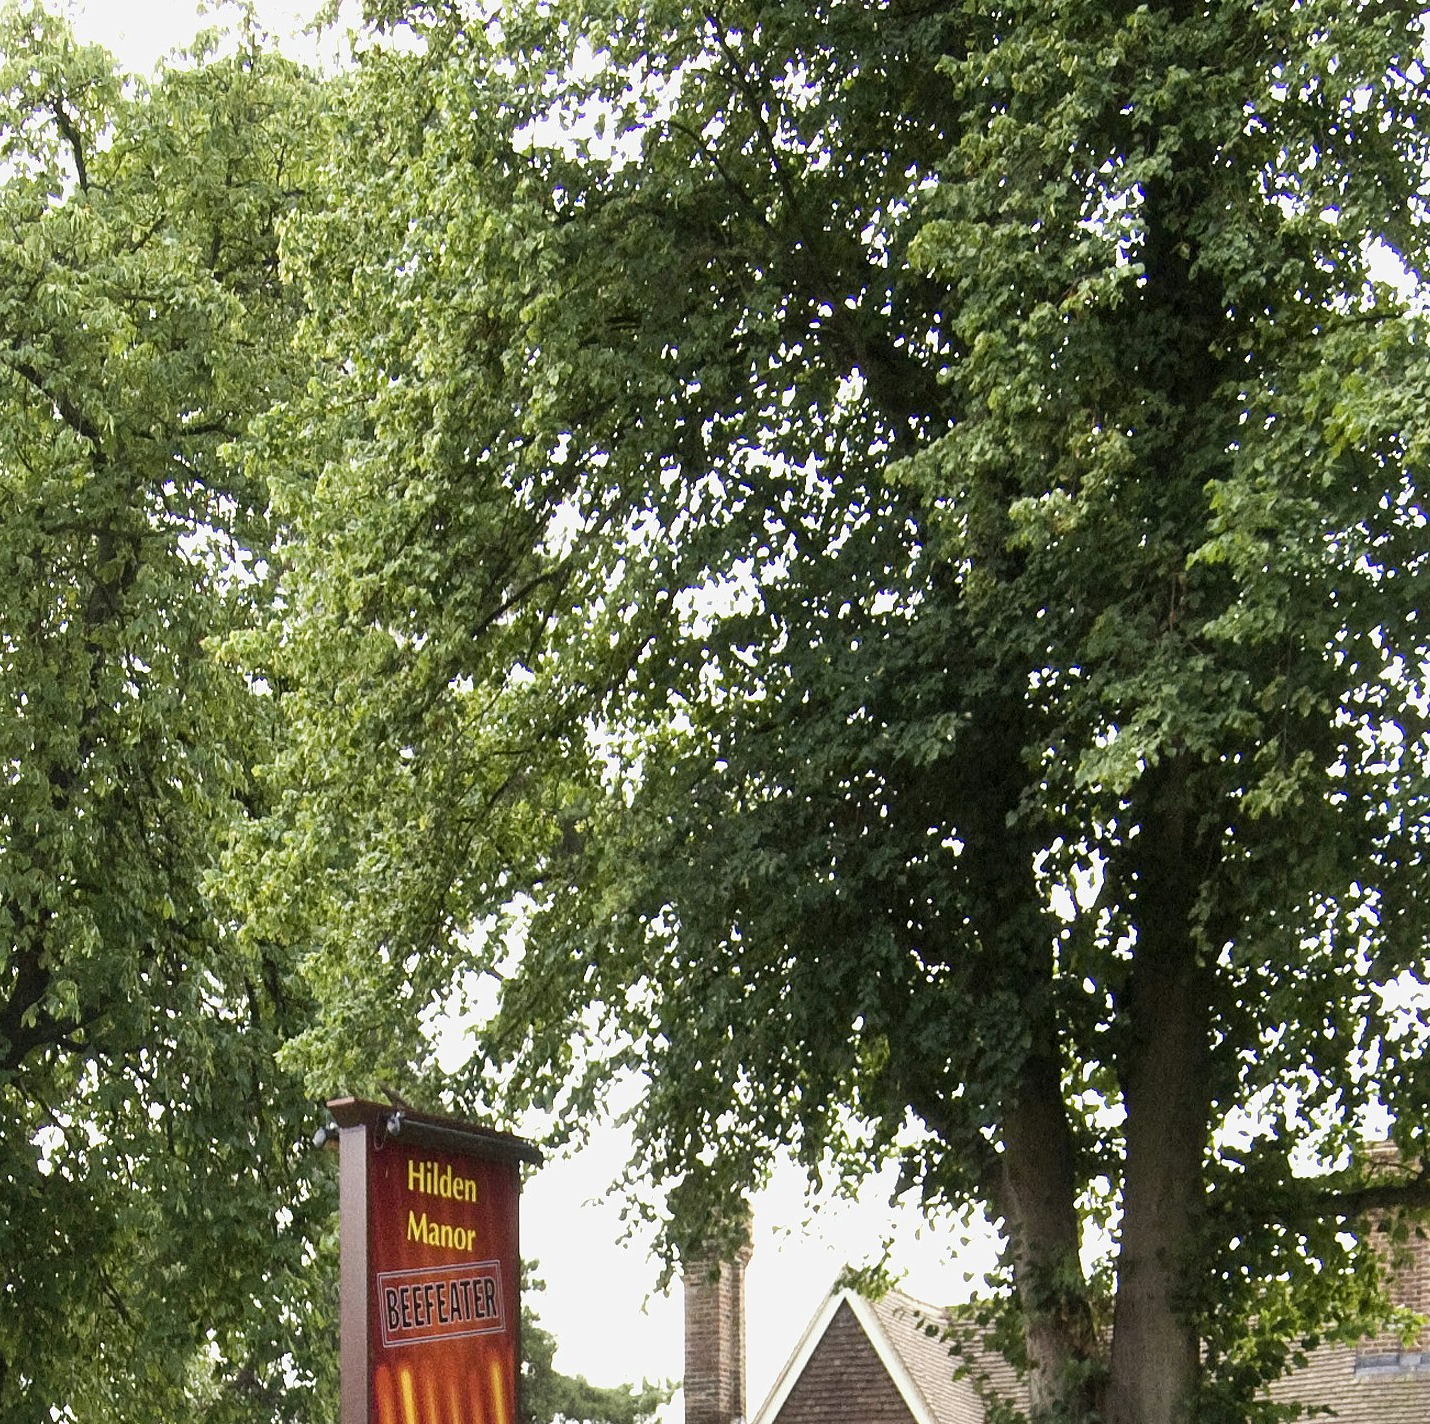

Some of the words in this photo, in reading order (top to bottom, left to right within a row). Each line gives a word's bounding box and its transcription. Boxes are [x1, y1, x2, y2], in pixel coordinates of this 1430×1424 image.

[408, 1159, 477, 1202] Hilden
[407, 1210, 476, 1251] Manor
[385, 1276, 498, 1331] BEEFEATER
